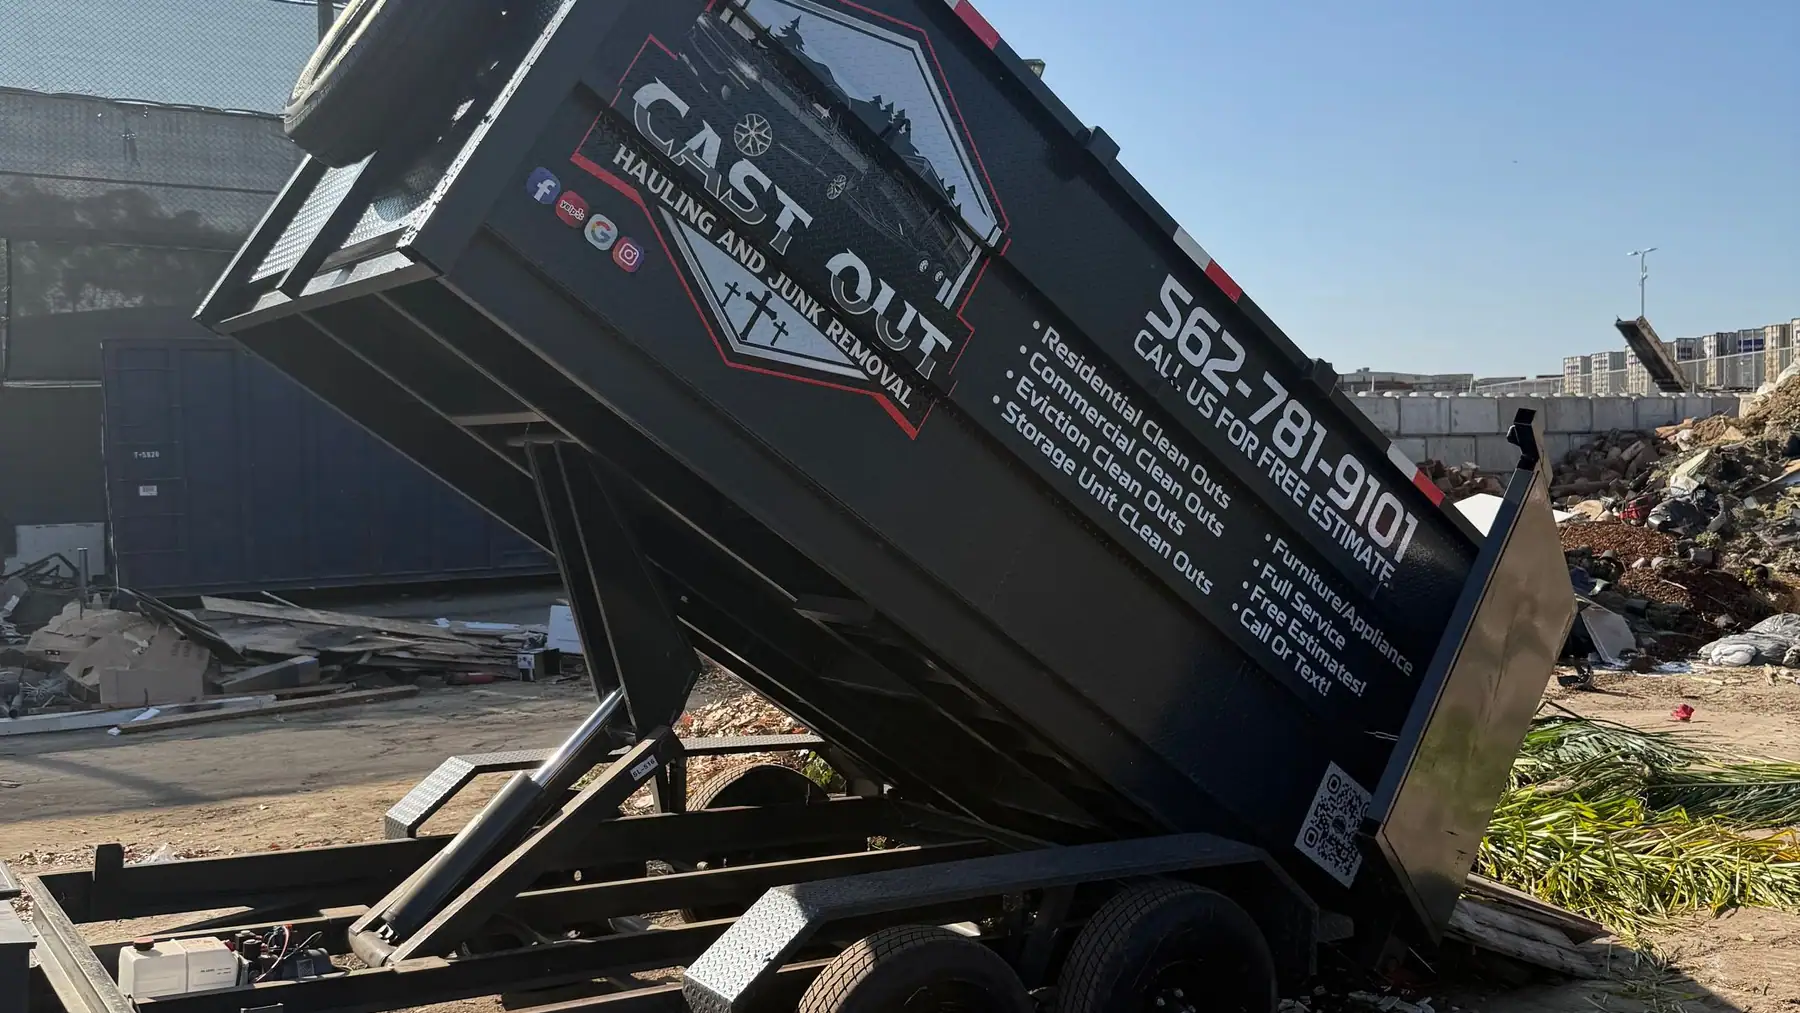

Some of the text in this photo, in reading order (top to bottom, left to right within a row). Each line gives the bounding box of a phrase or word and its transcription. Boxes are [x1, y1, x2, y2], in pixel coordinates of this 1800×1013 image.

[612, 143, 912, 409] HAULING AND JUNK REMOVAL
[632, 76, 952, 380] CAST OUT
[1001, 401, 1076, 476] Storage
[1078, 465, 1119, 513] Unit
[1172, 550, 1214, 595] Outs
[1015, 375, 1186, 536] Eviction Clean Outs
[1029, 353, 1225, 538] Commercial Clean Outs
[1042, 326, 1231, 510] Residential Clean Outs
[1134, 329, 1396, 588] CALL US FOR FREE ESTIMATE
[1145, 273, 1419, 563] 562-781-9101
[1240, 607, 1333, 697] Call Or Text!
[1250, 584, 1368, 698] Free Estimates!
[1260, 562, 1346, 651] Full Service
[1272, 537, 1414, 677] Furniture/Appliance
